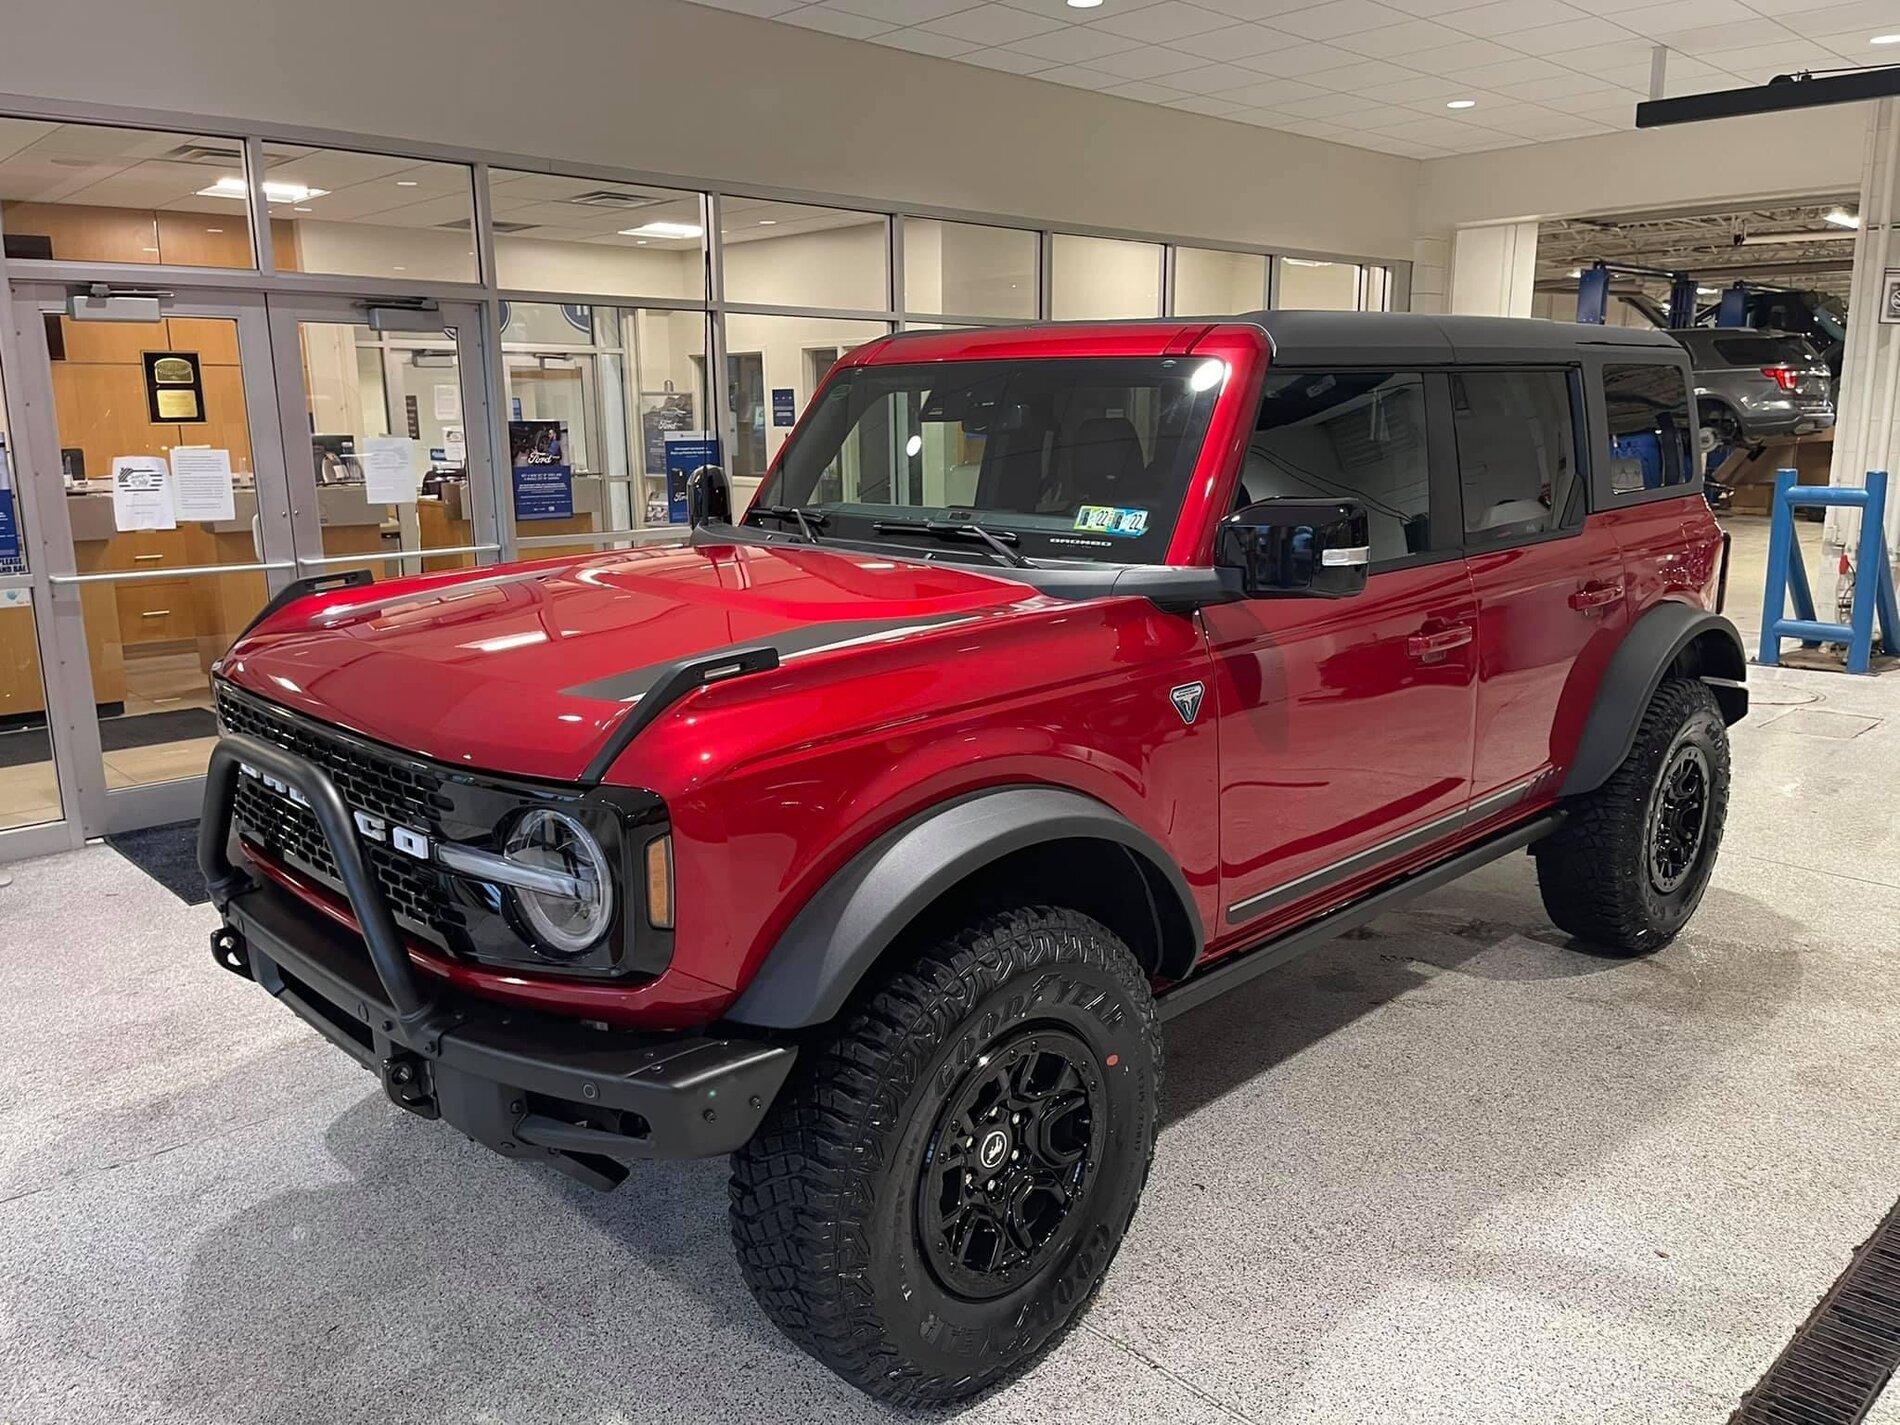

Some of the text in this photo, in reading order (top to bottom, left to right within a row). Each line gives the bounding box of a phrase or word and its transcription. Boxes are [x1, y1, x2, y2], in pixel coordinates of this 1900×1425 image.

[528, 452, 553, 464] Ford
[1096, 511, 1109, 526] 22
[1129, 514, 1143, 530] 22
[1049, 538, 1112, 547] BRONCO
